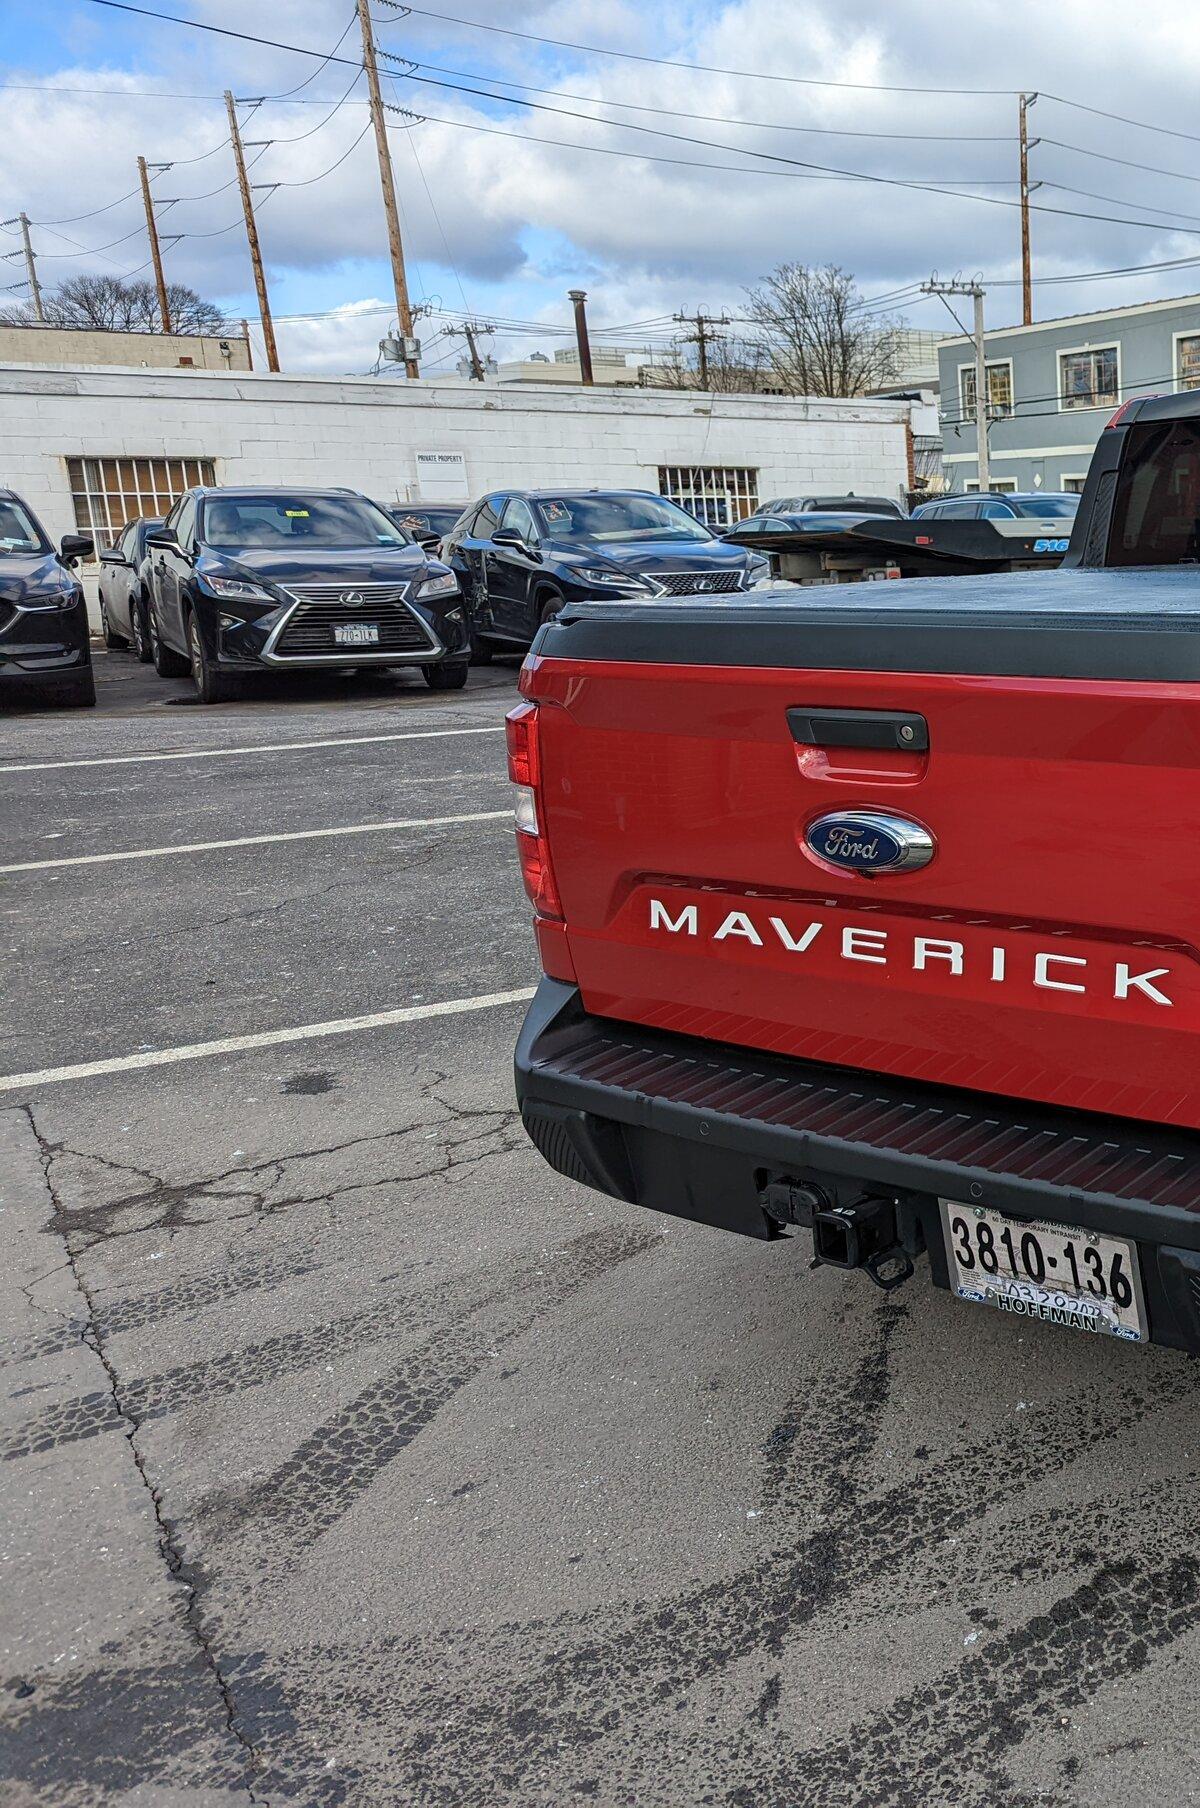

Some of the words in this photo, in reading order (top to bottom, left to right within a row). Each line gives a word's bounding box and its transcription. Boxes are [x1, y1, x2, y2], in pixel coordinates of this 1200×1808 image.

[417, 454, 437, 462] PRIVATE
[1033, 538, 1070, 552] 516
[825, 827, 879, 860] Ford
[649, 898, 1174, 1007] MAVERICK
[1013, 1221, 1049, 1235] TEMPORARY
[952, 1216, 1133, 1309] 3810-136
[998, 1293, 1098, 1332] HOFFMAN
